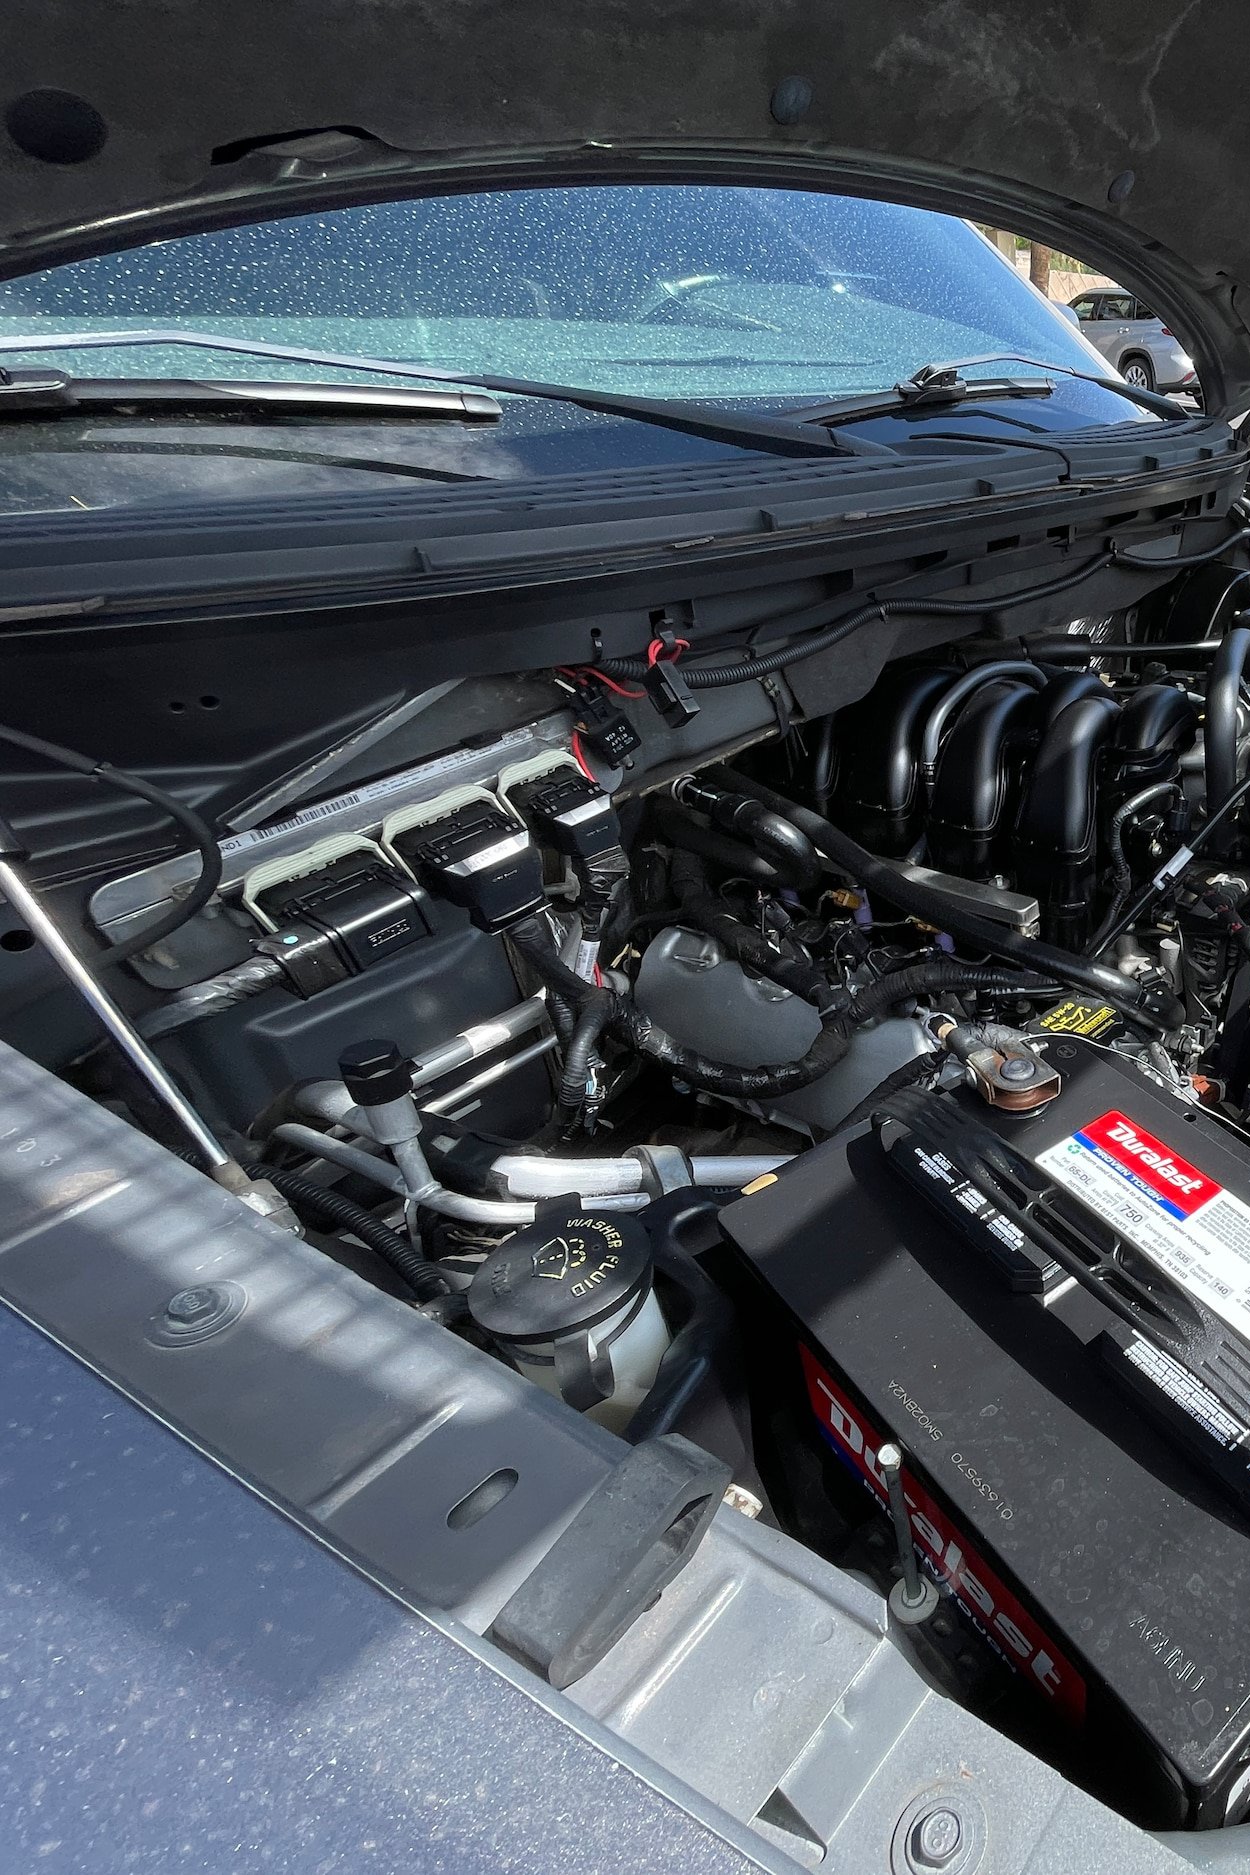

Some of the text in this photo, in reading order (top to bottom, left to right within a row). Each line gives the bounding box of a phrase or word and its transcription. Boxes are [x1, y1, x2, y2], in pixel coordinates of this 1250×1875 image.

[1040, 1015, 1055, 1027] SAE
[932, 1154, 950, 1171] GASES
[1105, 1120, 1202, 1194] Duralast
[1067, 1164, 1093, 1185] 65-DL
[1092, 1147, 1163, 1202] PROVEN TOUGH
[1078, 1151, 1098, 1166] Return
[1094, 1163, 1110, 1175] used
[1106, 1173, 1131, 1192] batteries
[1134, 1194, 1161, 1216] AutoZone
[1159, 1214, 1169, 1222] for
[1166, 1220, 1186, 1236] proper
[1184, 1234, 1211, 1256] recycling
[1118, 1203, 1144, 1224] 750
[1065, 1179, 1096, 1203] DISTRIBUTED
[1093, 1201, 1103, 1209] BY
[1099, 1207, 1114, 1218] BEST
[1163, 1258, 1174, 1267] TN
[566, 1219, 623, 1297] WASHER FLUID
[1173, 1250, 1190, 1264] 935
[1188, 1267, 1208, 1284] Capacity
[1194, 1263, 1214, 1279] Reserve
[1212, 1281, 1229, 1295] 140
[1135, 1340, 1238, 1435] CAUTION: FOR SAFE JUMP STARTING FOLLOW
[1138, 1362, 1165, 1387] AVAILABLE
[1174, 1395, 1197, 1417] SERVICE
[1168, 1379, 1189, 1399] VEHICLE
[863, 1478, 1018, 1673] PROEN TOUGH
